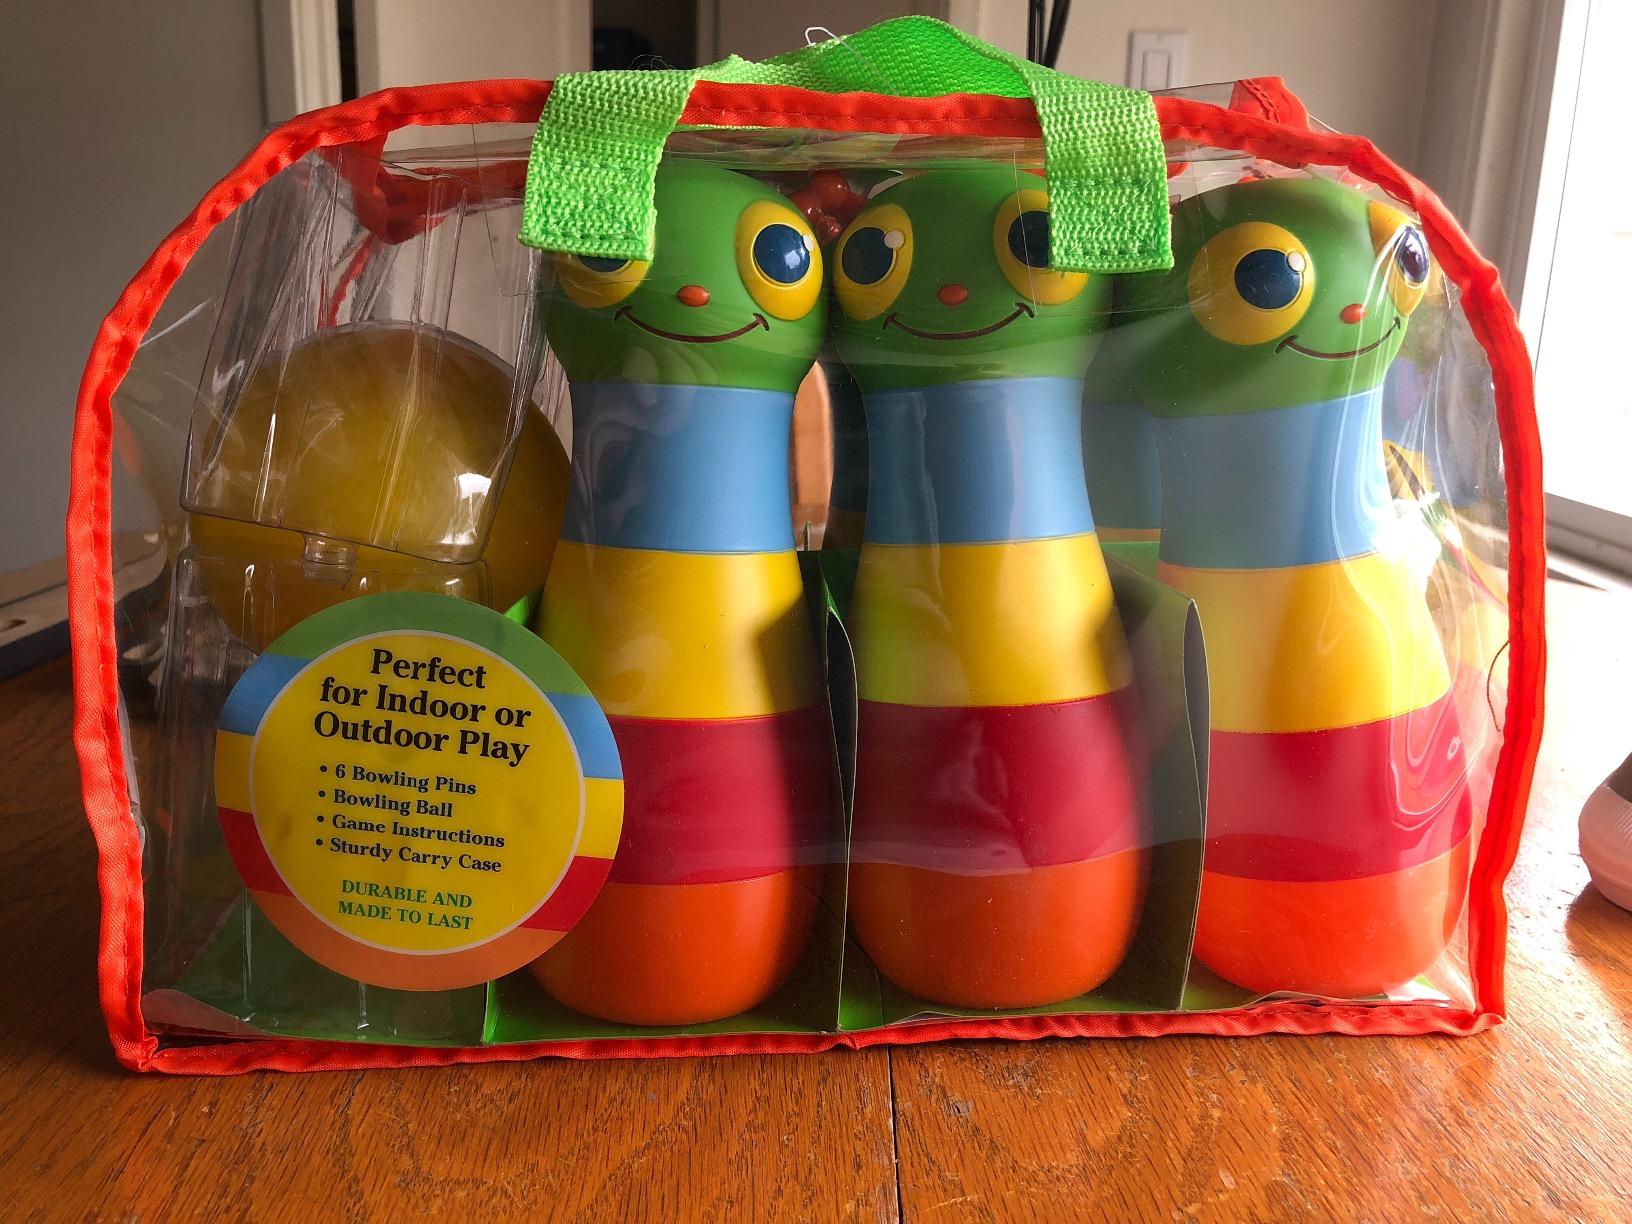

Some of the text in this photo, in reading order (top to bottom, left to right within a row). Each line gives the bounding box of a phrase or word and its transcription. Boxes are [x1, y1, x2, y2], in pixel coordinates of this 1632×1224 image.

[370, 648, 487, 689] Perfect
[319, 676, 532, 728] for Indoor or
[314, 711, 530, 767] Outdoor Play
[335, 763, 477, 795] 6 Bowling Pins
[333, 788, 453, 818] Bowling Ball
[332, 814, 505, 848] Game Instructions
[330, 837, 502, 873] Sturdy Carry Case
[341, 879, 473, 908] DURABLE AND
[338, 900, 473, 930] MADE TO LAST
